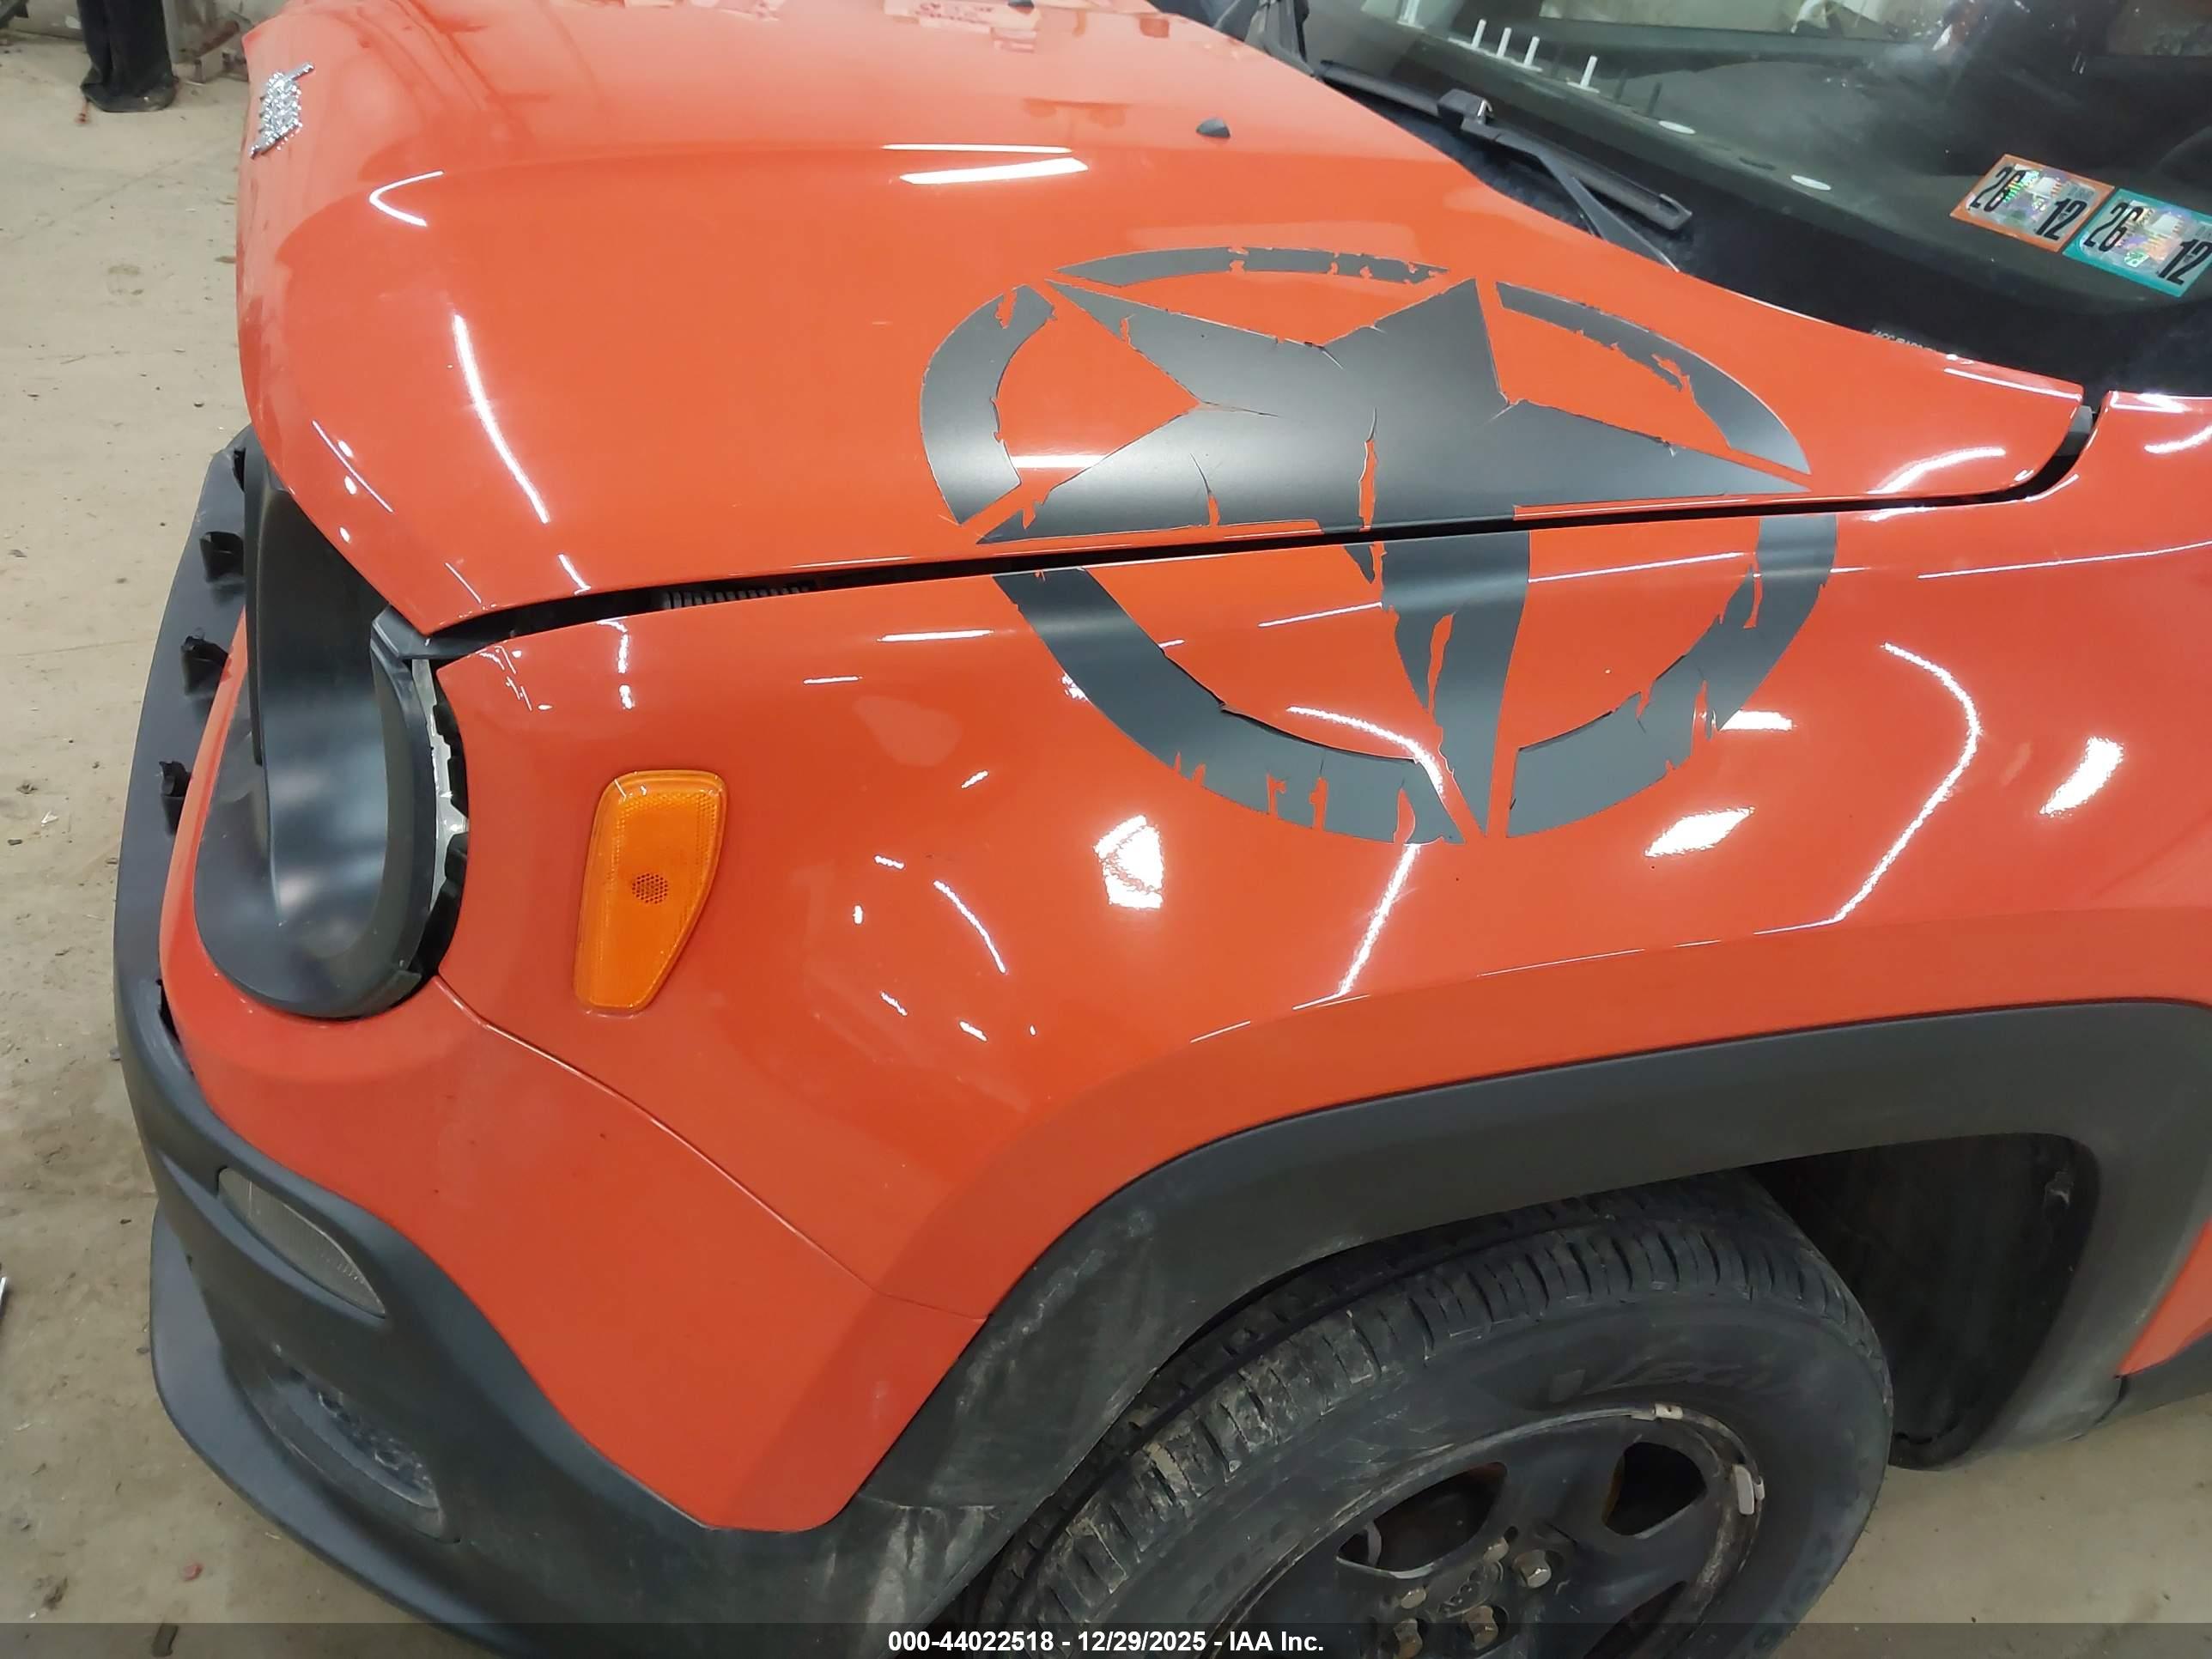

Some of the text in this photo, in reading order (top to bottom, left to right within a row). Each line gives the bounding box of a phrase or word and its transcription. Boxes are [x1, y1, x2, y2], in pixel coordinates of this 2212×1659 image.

[1969, 166, 2087, 240] 26 12
[2083, 202, 2212, 285] 26 12
